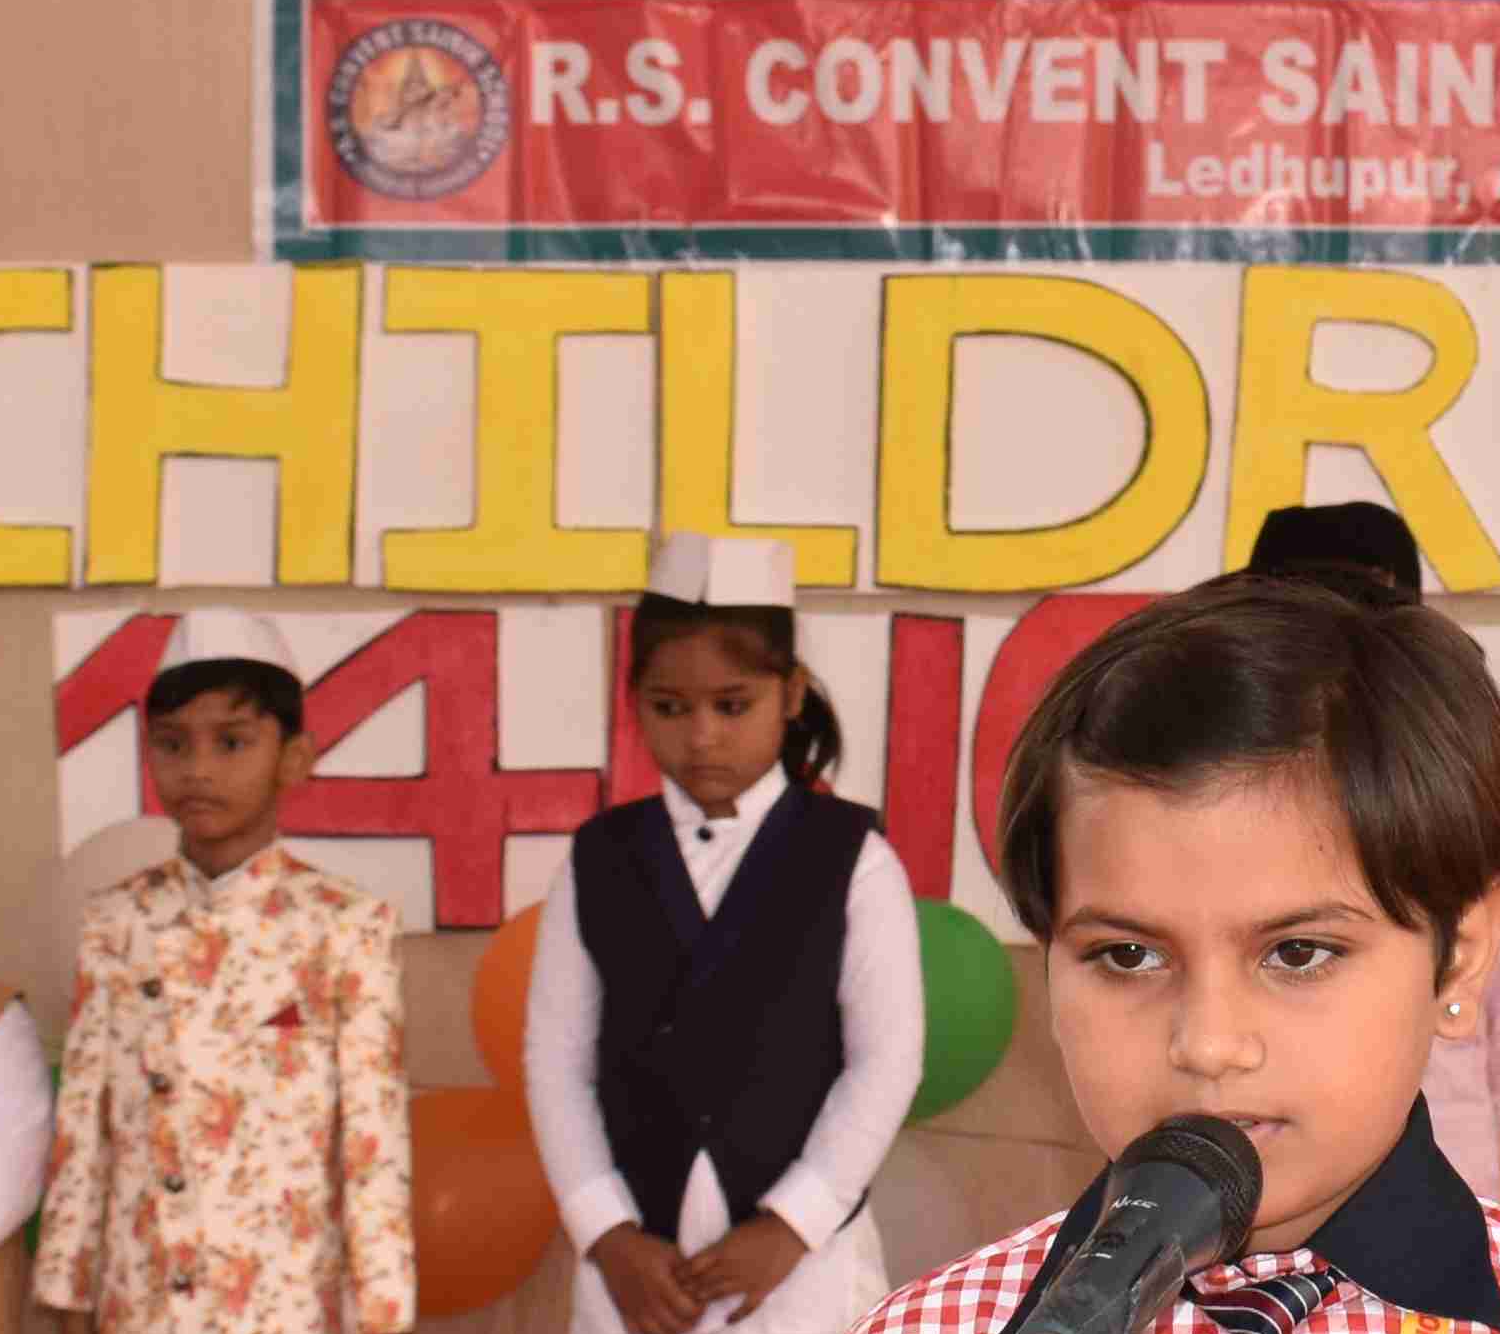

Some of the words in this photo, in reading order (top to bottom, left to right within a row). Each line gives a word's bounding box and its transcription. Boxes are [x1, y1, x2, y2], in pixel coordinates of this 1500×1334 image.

[530, 40, 712, 126] R.S.
[745, 37, 1227, 125] CONVENT
[1147, 142, 1472, 210] Ledhupur,
